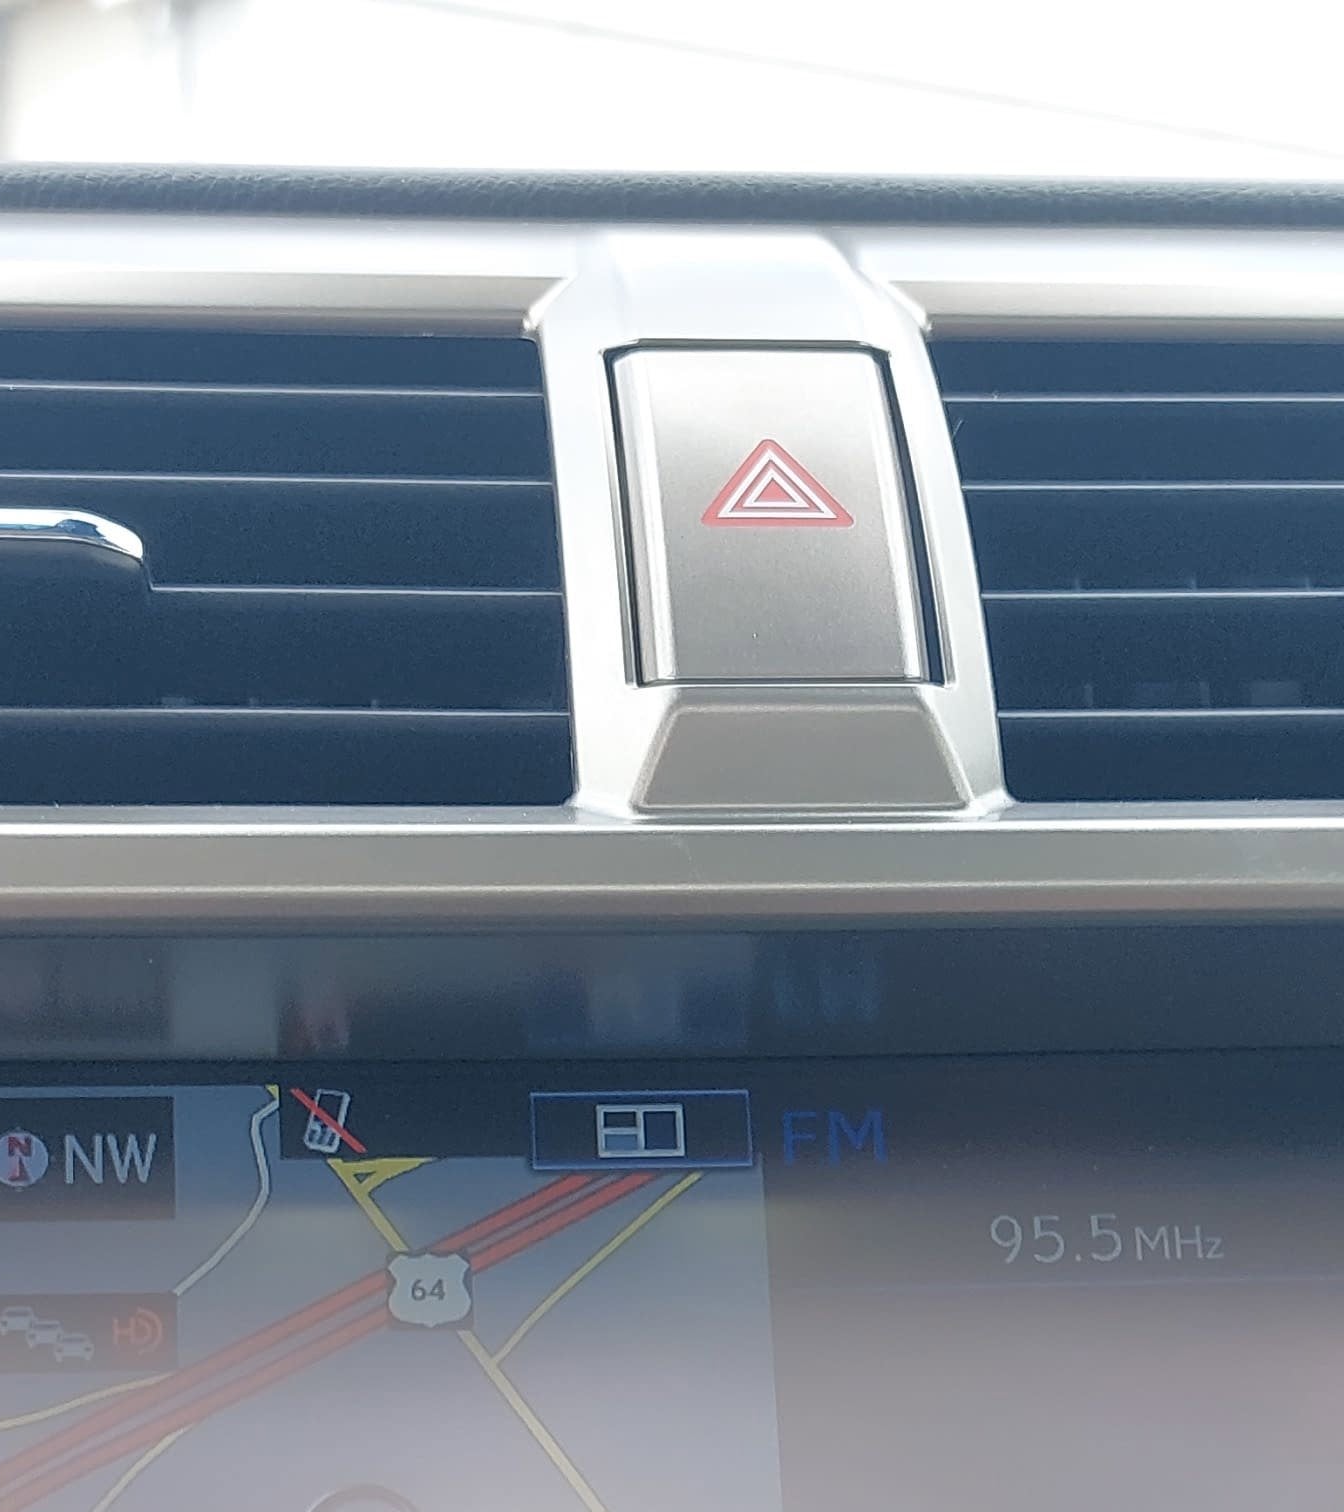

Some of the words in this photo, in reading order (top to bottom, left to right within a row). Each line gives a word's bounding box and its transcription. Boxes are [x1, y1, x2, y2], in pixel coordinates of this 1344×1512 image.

[63, 1132, 157, 1185] NW
[782, 1109, 887, 1166] FM
[410, 1278, 447, 1304] 64
